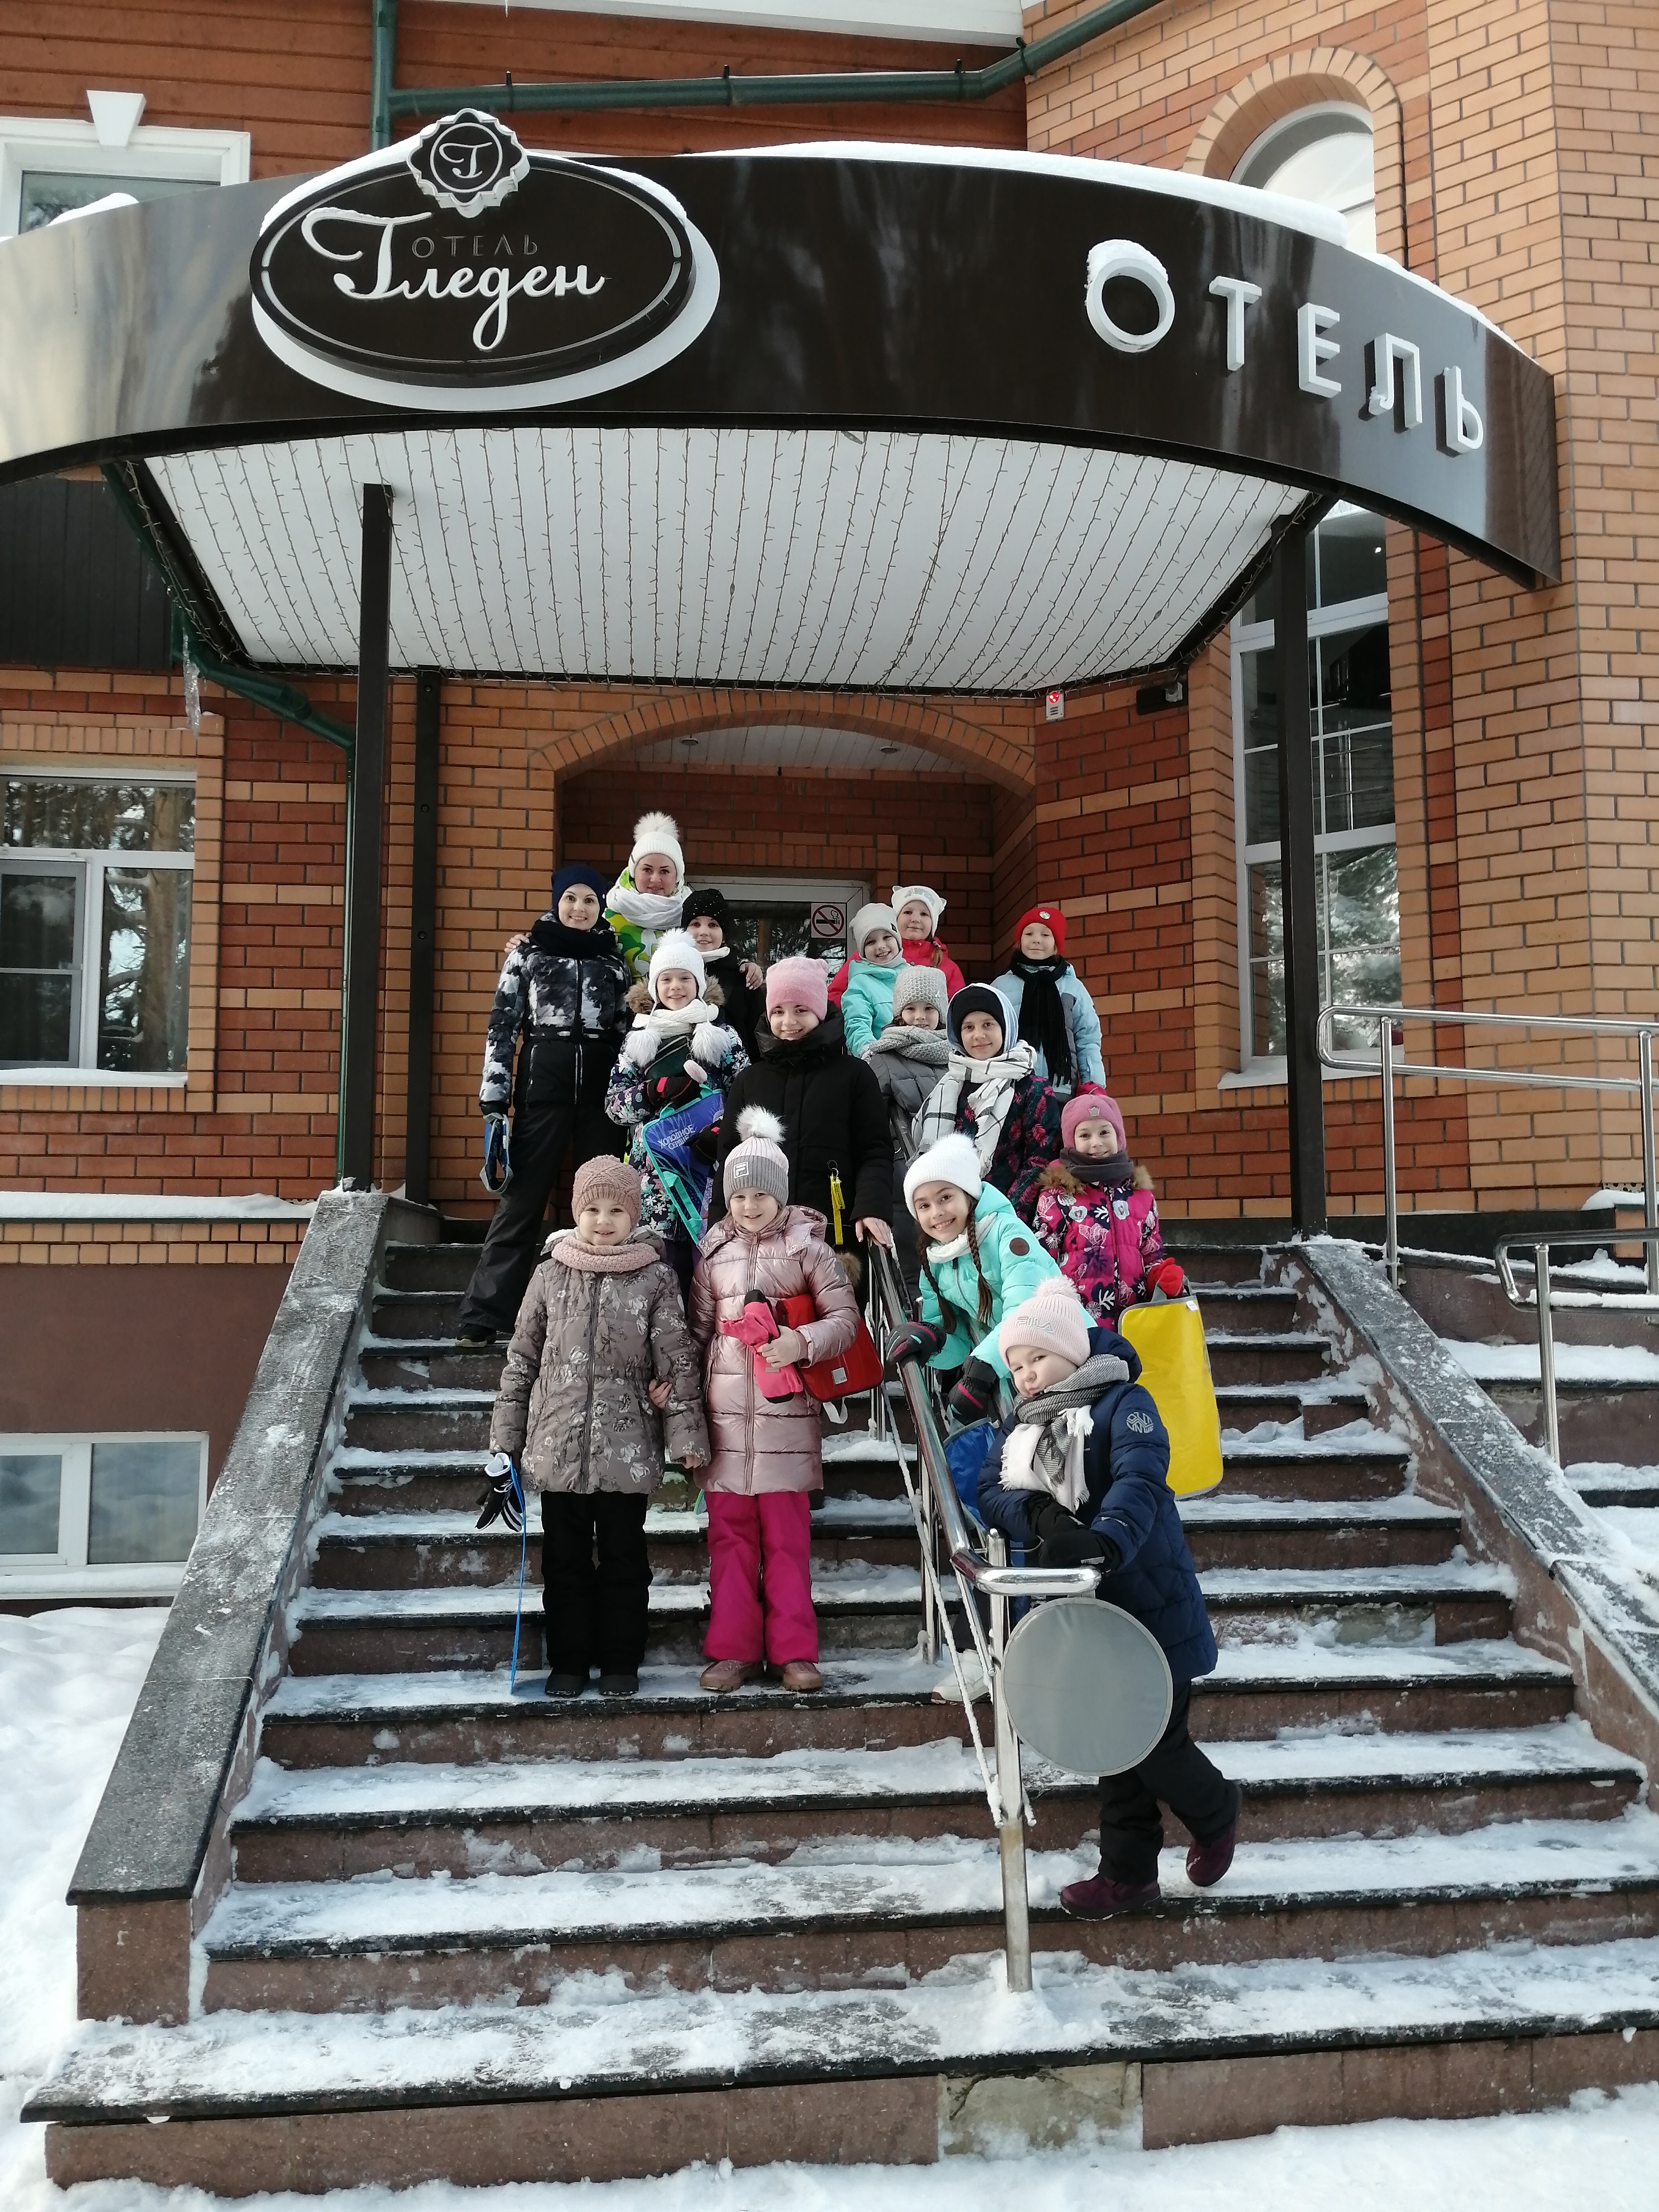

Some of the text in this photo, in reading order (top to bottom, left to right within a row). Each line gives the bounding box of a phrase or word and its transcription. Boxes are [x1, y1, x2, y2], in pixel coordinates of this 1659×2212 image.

[411, 234, 539, 259] ОТЕЛЬ
[300, 207, 607, 351] Гледен
[1085, 257, 1484, 455] ОТЕЛЬ
[657, 1124, 696, 1149] ХОЛОДНОЕ
[1015, 1316, 1054, 1334] FILA
